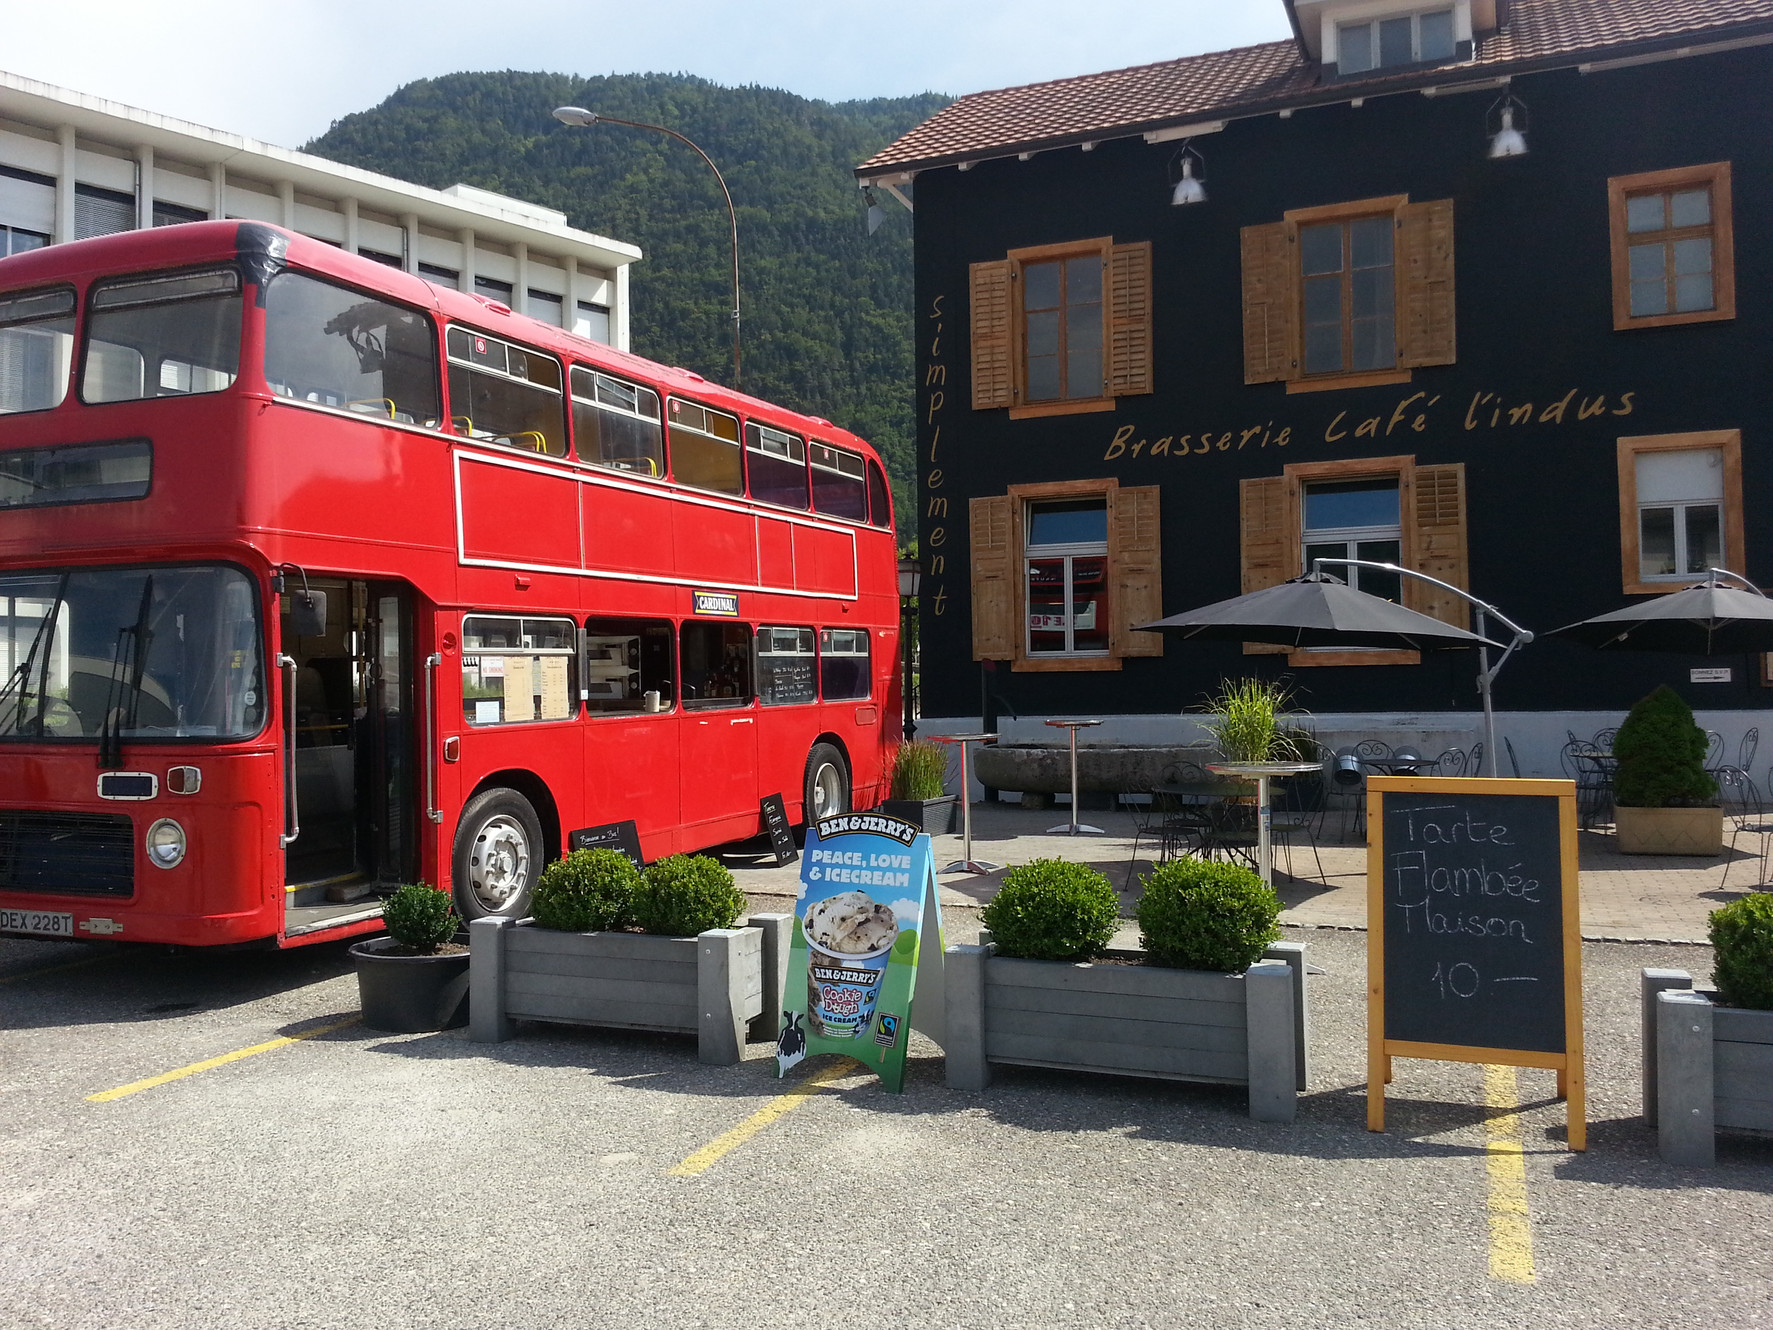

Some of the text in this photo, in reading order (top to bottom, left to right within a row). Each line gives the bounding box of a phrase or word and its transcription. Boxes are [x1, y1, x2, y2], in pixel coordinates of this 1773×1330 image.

[1104, 424, 1291, 461] Brasserie
[1464, 388, 1636, 430] l'indus
[926, 295, 949, 617] simplement
[699, 596, 735, 611] CARDINAL
[1390, 805, 1516, 845] Tarte
[811, 849, 867, 868] PEACE,
[869, 853, 911, 869] LOVE
[808, 866, 910, 887] & ICECREAM
[1390, 850, 1540, 903] Flambée
[0, 911, 72, 933] DEX 228T
[1394, 895, 1533, 944] Maison
[823, 986, 862, 1003] Cookie
[822, 1013, 858, 1024] ICE CREAM
